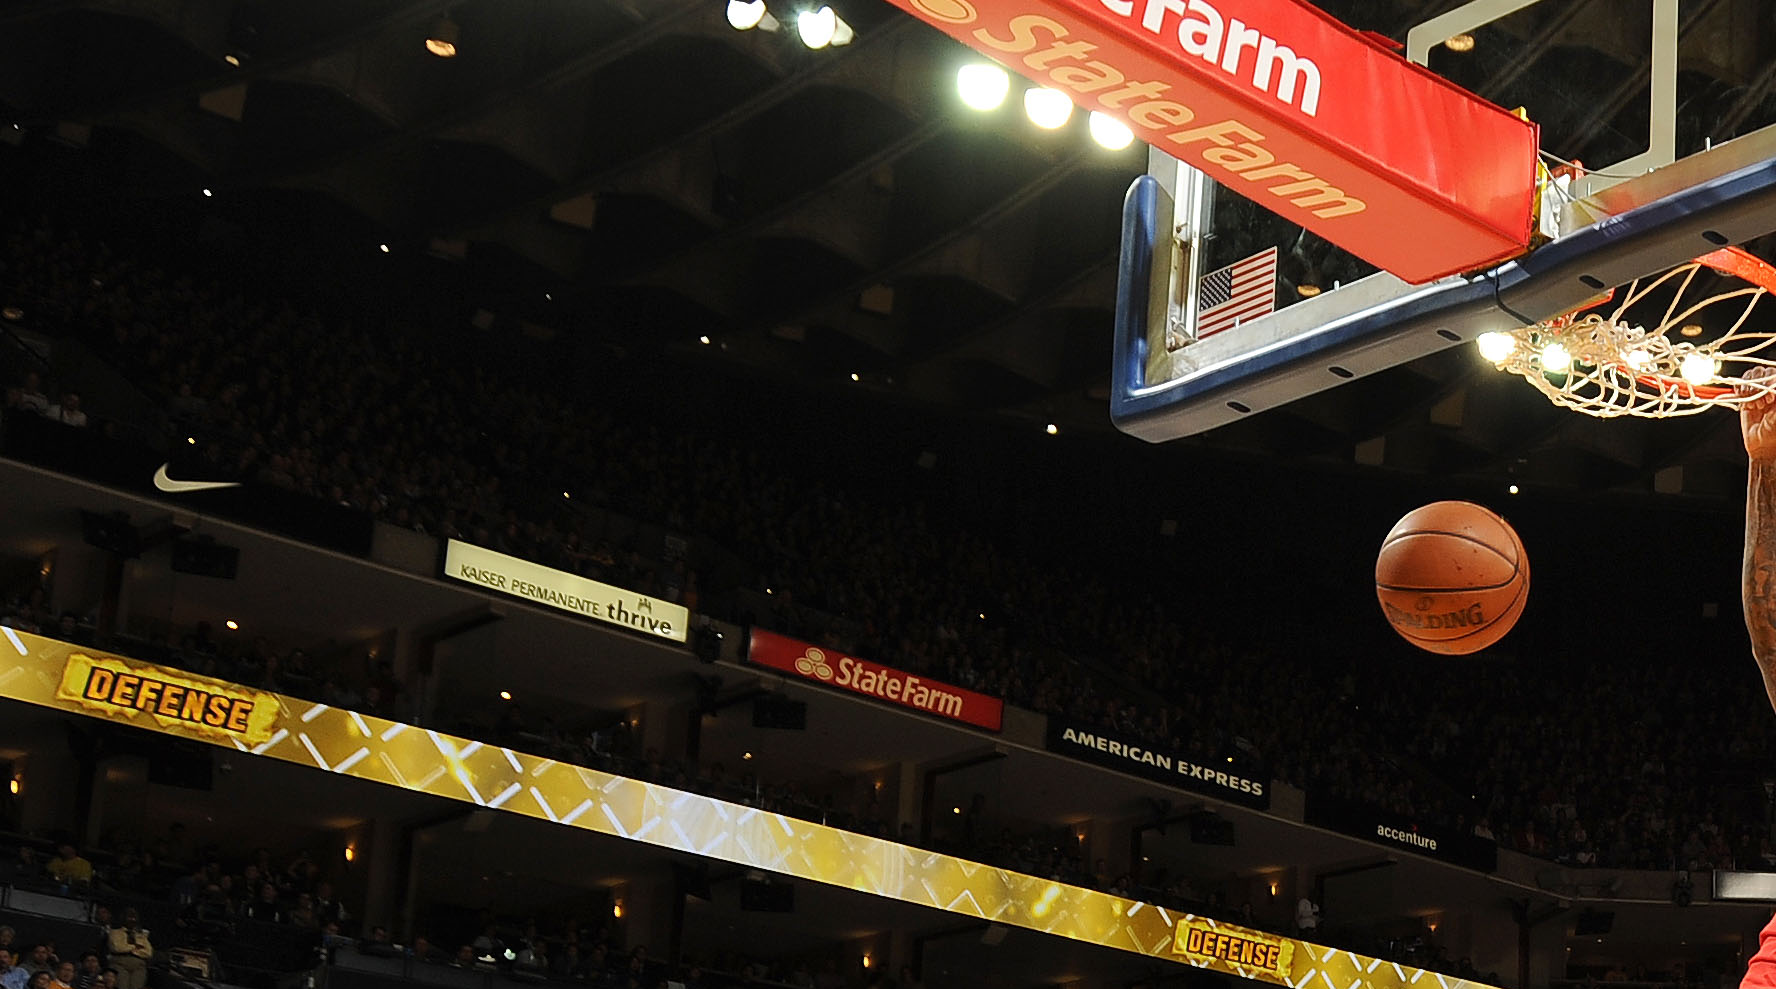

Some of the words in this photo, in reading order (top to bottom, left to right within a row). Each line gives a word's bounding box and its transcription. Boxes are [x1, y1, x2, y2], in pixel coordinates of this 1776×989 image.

[460, 564, 506, 589] KAISER
[512, 580, 600, 615] PERMANENTE
[606, 600, 672, 635] thrive
[83, 665, 254, 734] DEFENSE
[1062, 727, 1172, 771] AMERICAN
[1177, 760, 1264, 797] EXPRESS
[1377, 823, 1437, 850] accenture
[1186, 927, 1281, 970] DEFENSE
